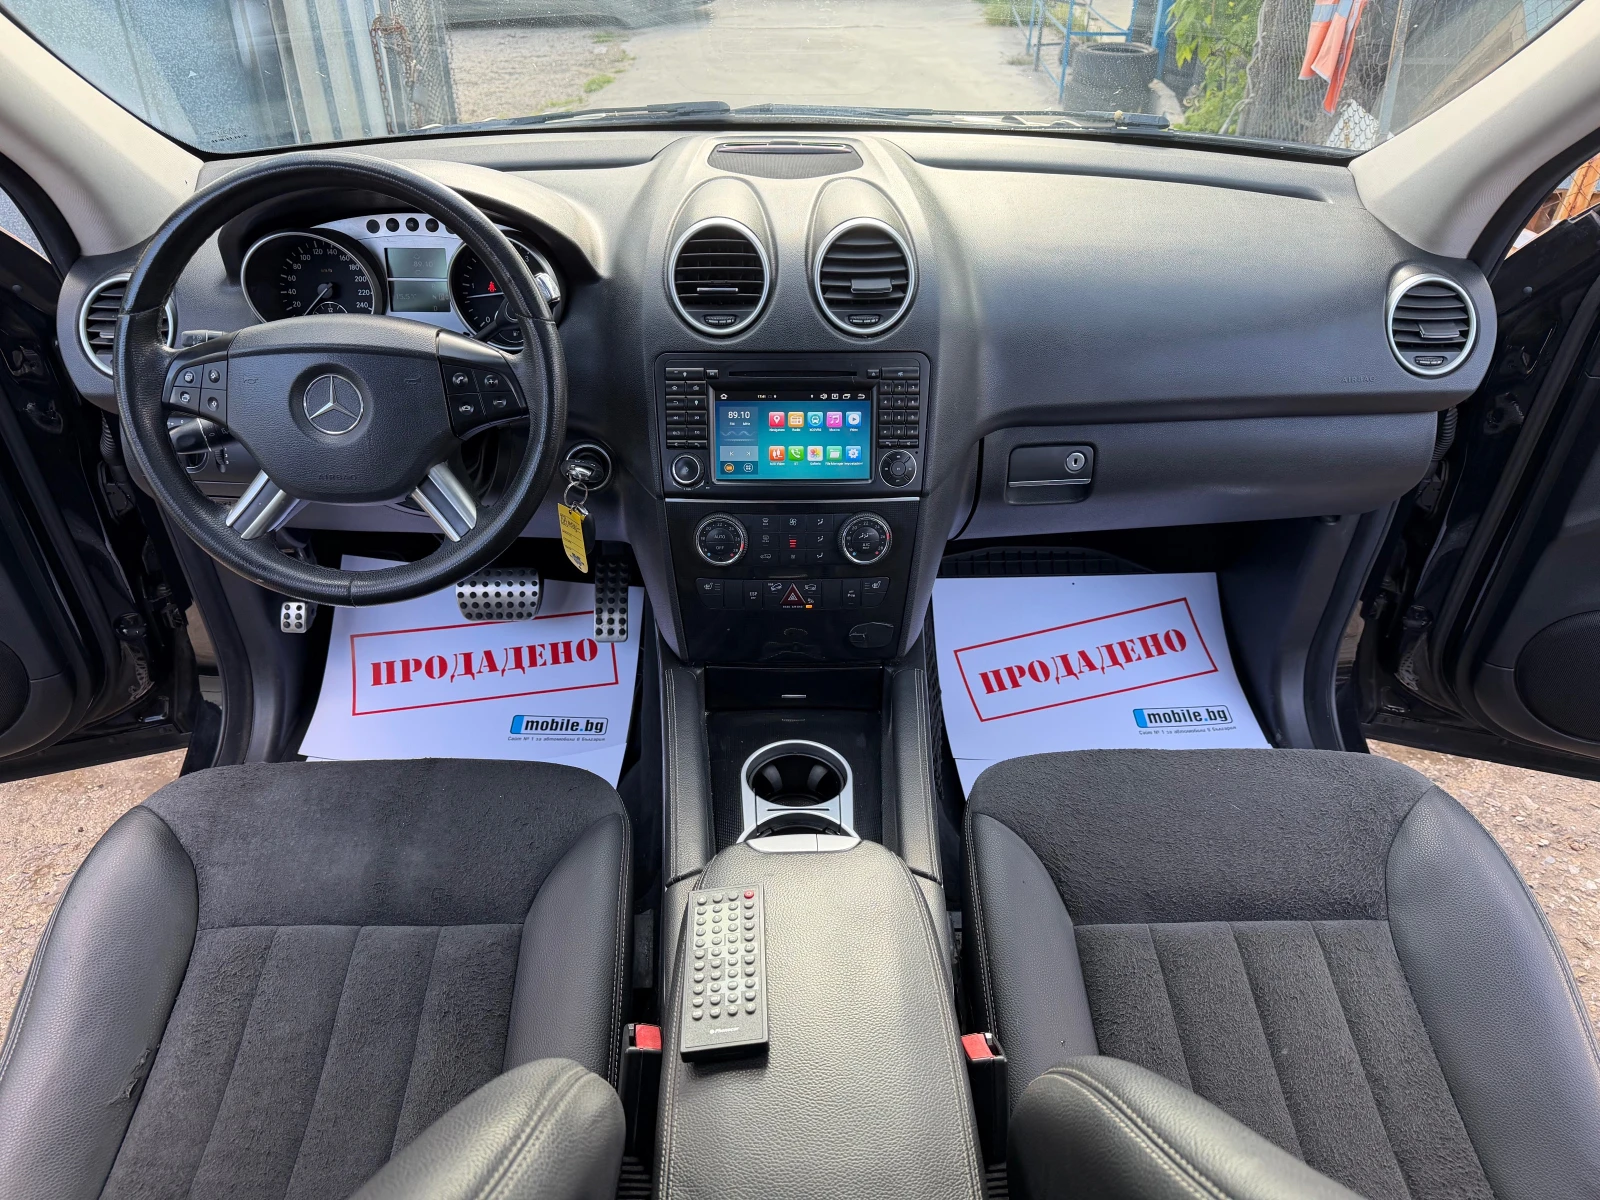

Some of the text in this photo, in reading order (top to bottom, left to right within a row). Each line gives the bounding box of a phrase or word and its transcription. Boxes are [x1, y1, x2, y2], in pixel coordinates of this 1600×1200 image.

[727, 411, 751, 419] 89.10
[370, 638, 598, 687] ПРОДАДЕНО
[978, 628, 1187, 695] ПРОДАДЕНО
[1147, 708, 1228, 724] mobile.bg
[524, 718, 605, 734] mobile.bg
